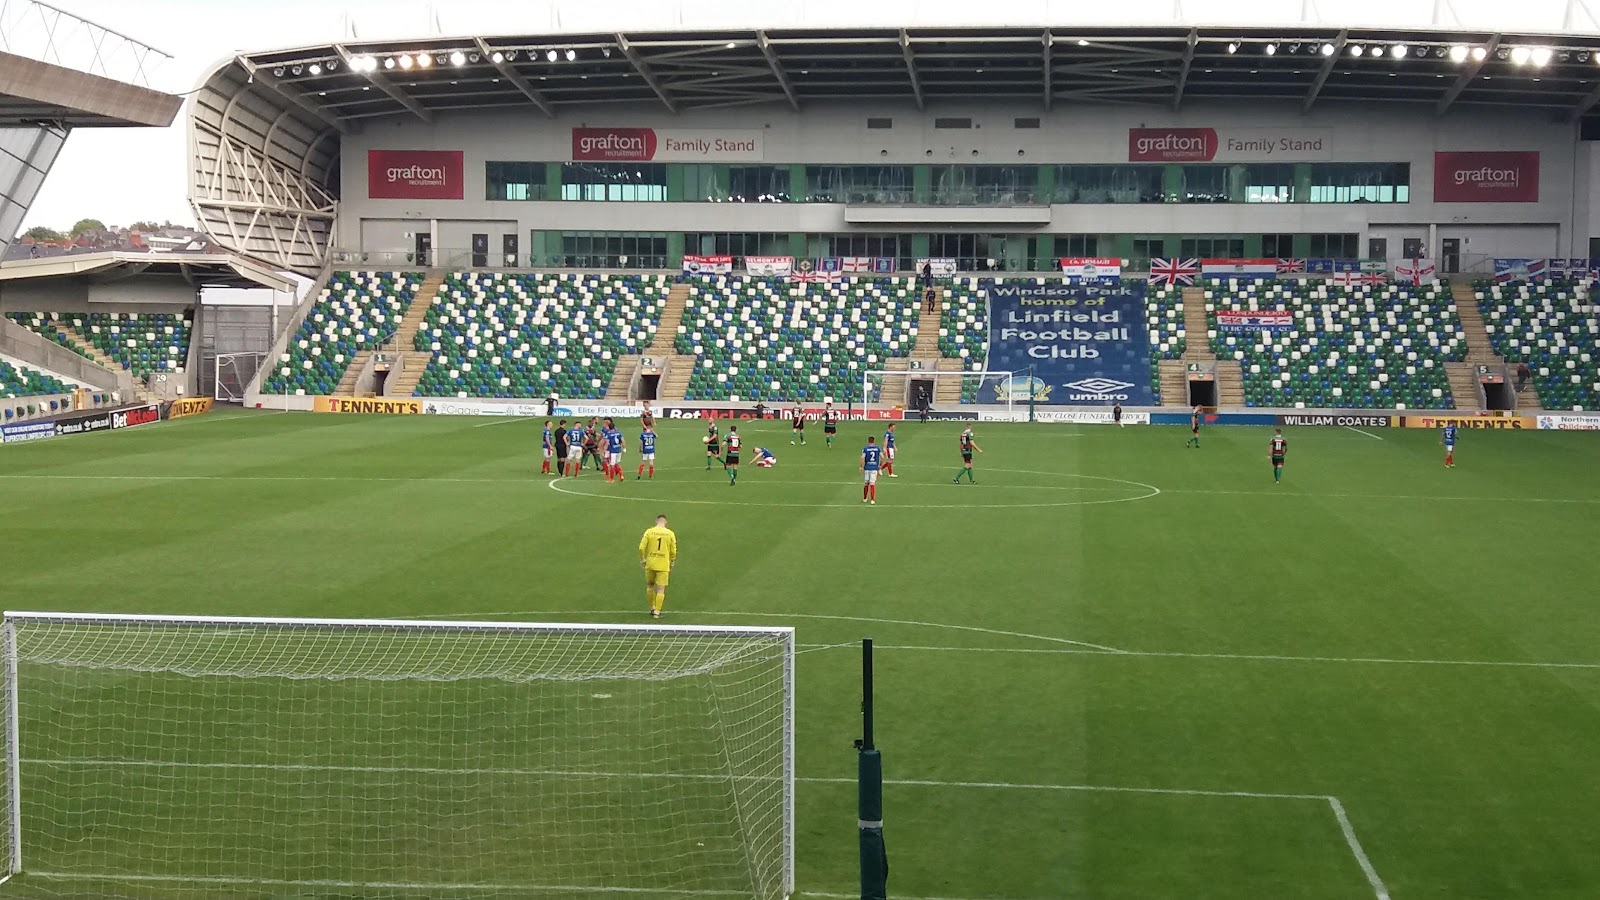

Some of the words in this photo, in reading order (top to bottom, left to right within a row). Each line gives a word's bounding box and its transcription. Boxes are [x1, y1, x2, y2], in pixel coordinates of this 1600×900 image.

[580, 134, 643, 153] grafton
[665, 138, 710, 155] Family
[715, 139, 755, 151] Stand
[1137, 134, 1203, 153] grafton
[1228, 138, 1274, 153] Family
[1280, 138, 1322, 151] Stand
[387, 165, 442, 182] grafton
[1454, 166, 1515, 185] grafton
[994, 287, 1079, 296] Windsor
[1086, 287, 1132, 296] Park
[1020, 297, 1077, 306] home
[1084, 297, 1106, 306] of
[1008, 309, 1119, 323] Linfield
[1001, 327, 1128, 341] Football
[1027, 345, 1100, 359] Club
[1069, 393, 1129, 401] umbro
[328, 399, 418, 415] TENNENT'S
[113, 409, 157, 428] BetMcLean
[1284, 416, 1333, 426] WILLIAM
[1337, 416, 1387, 427] COATES
[572, 433, 580, 441] 31
[614, 436, 620, 444] 6
[732, 437, 739, 447] 10
[1275, 442, 1282, 450] 11
[870, 452, 875, 461] 2
[656, 537, 663, 551] 1
